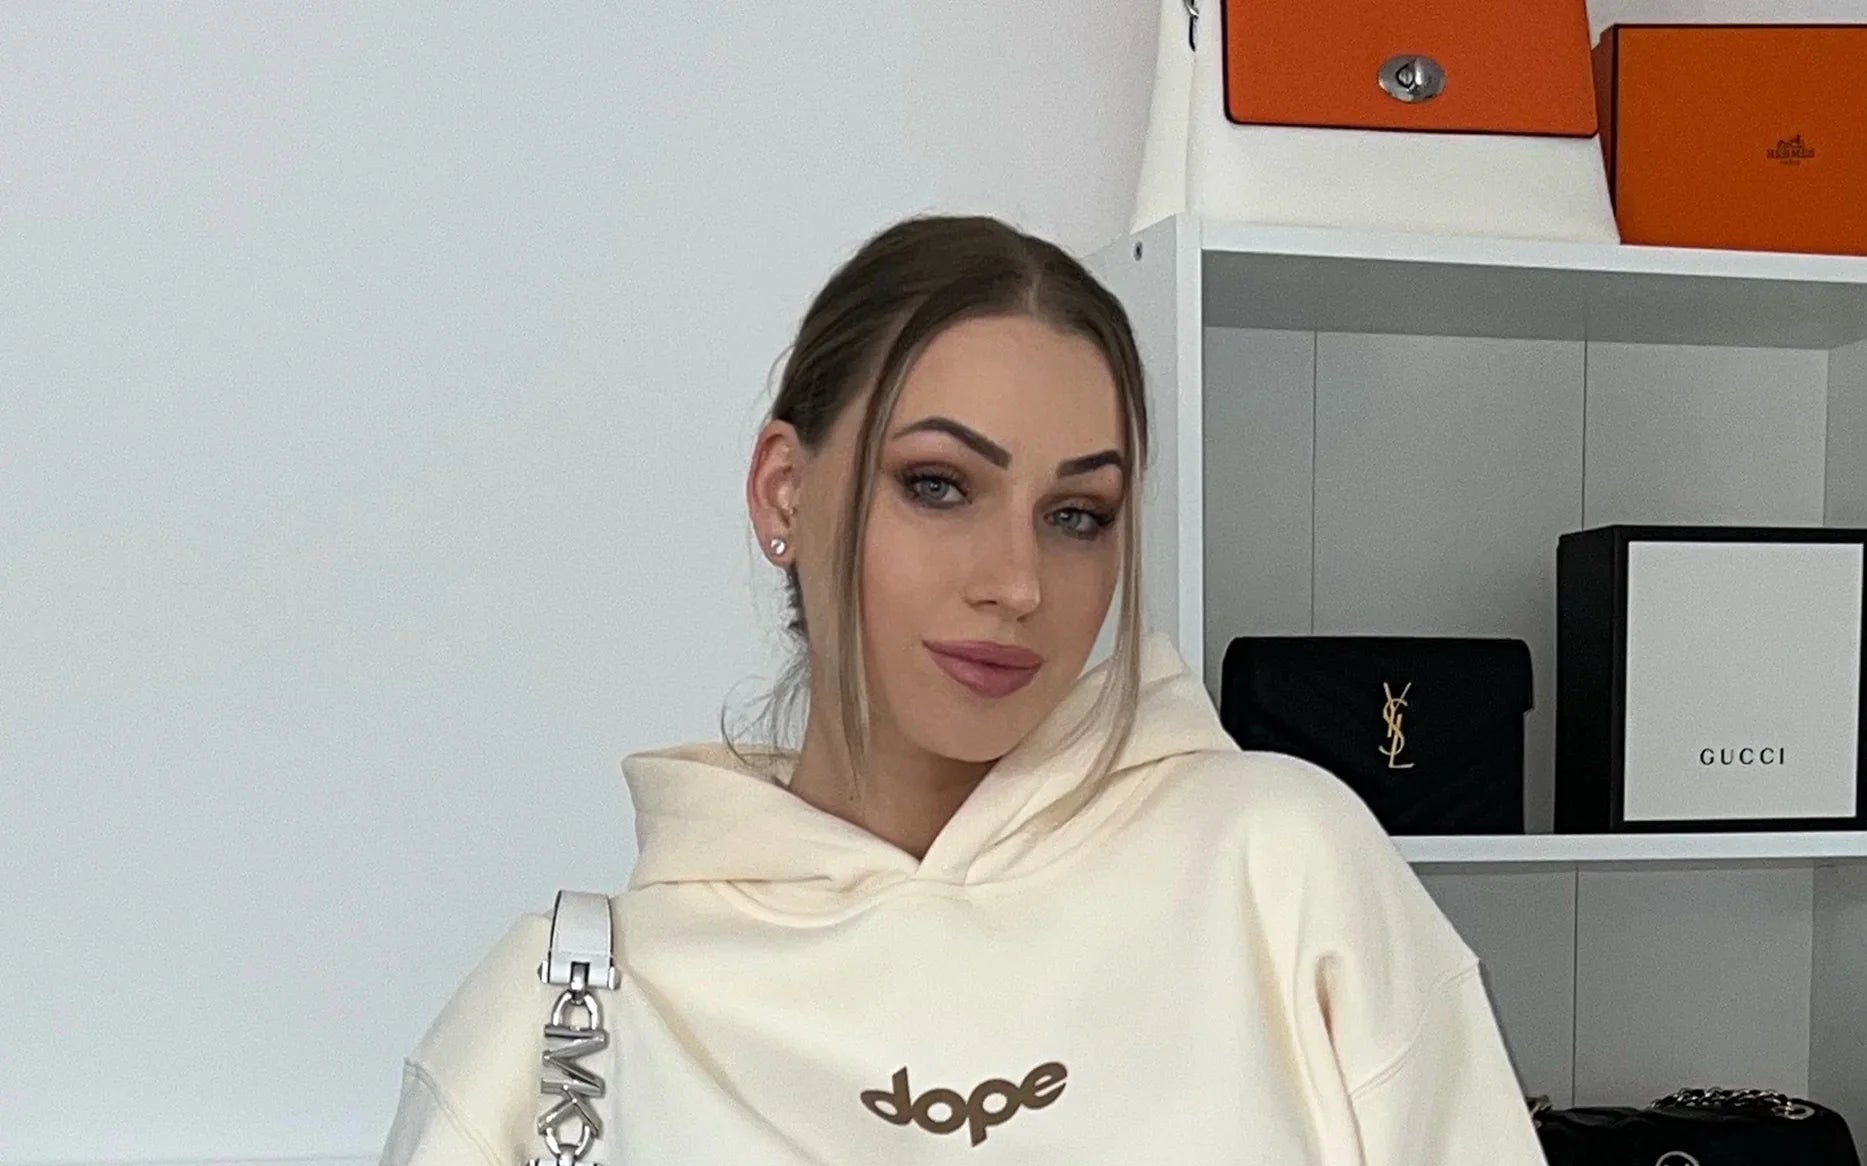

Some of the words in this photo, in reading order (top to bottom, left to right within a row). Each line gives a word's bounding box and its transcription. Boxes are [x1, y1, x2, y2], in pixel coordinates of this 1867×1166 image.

[1378, 682, 1415, 769] YSL
[1700, 747, 1784, 765] GUCCI
[860, 1061, 1068, 1148] dope
